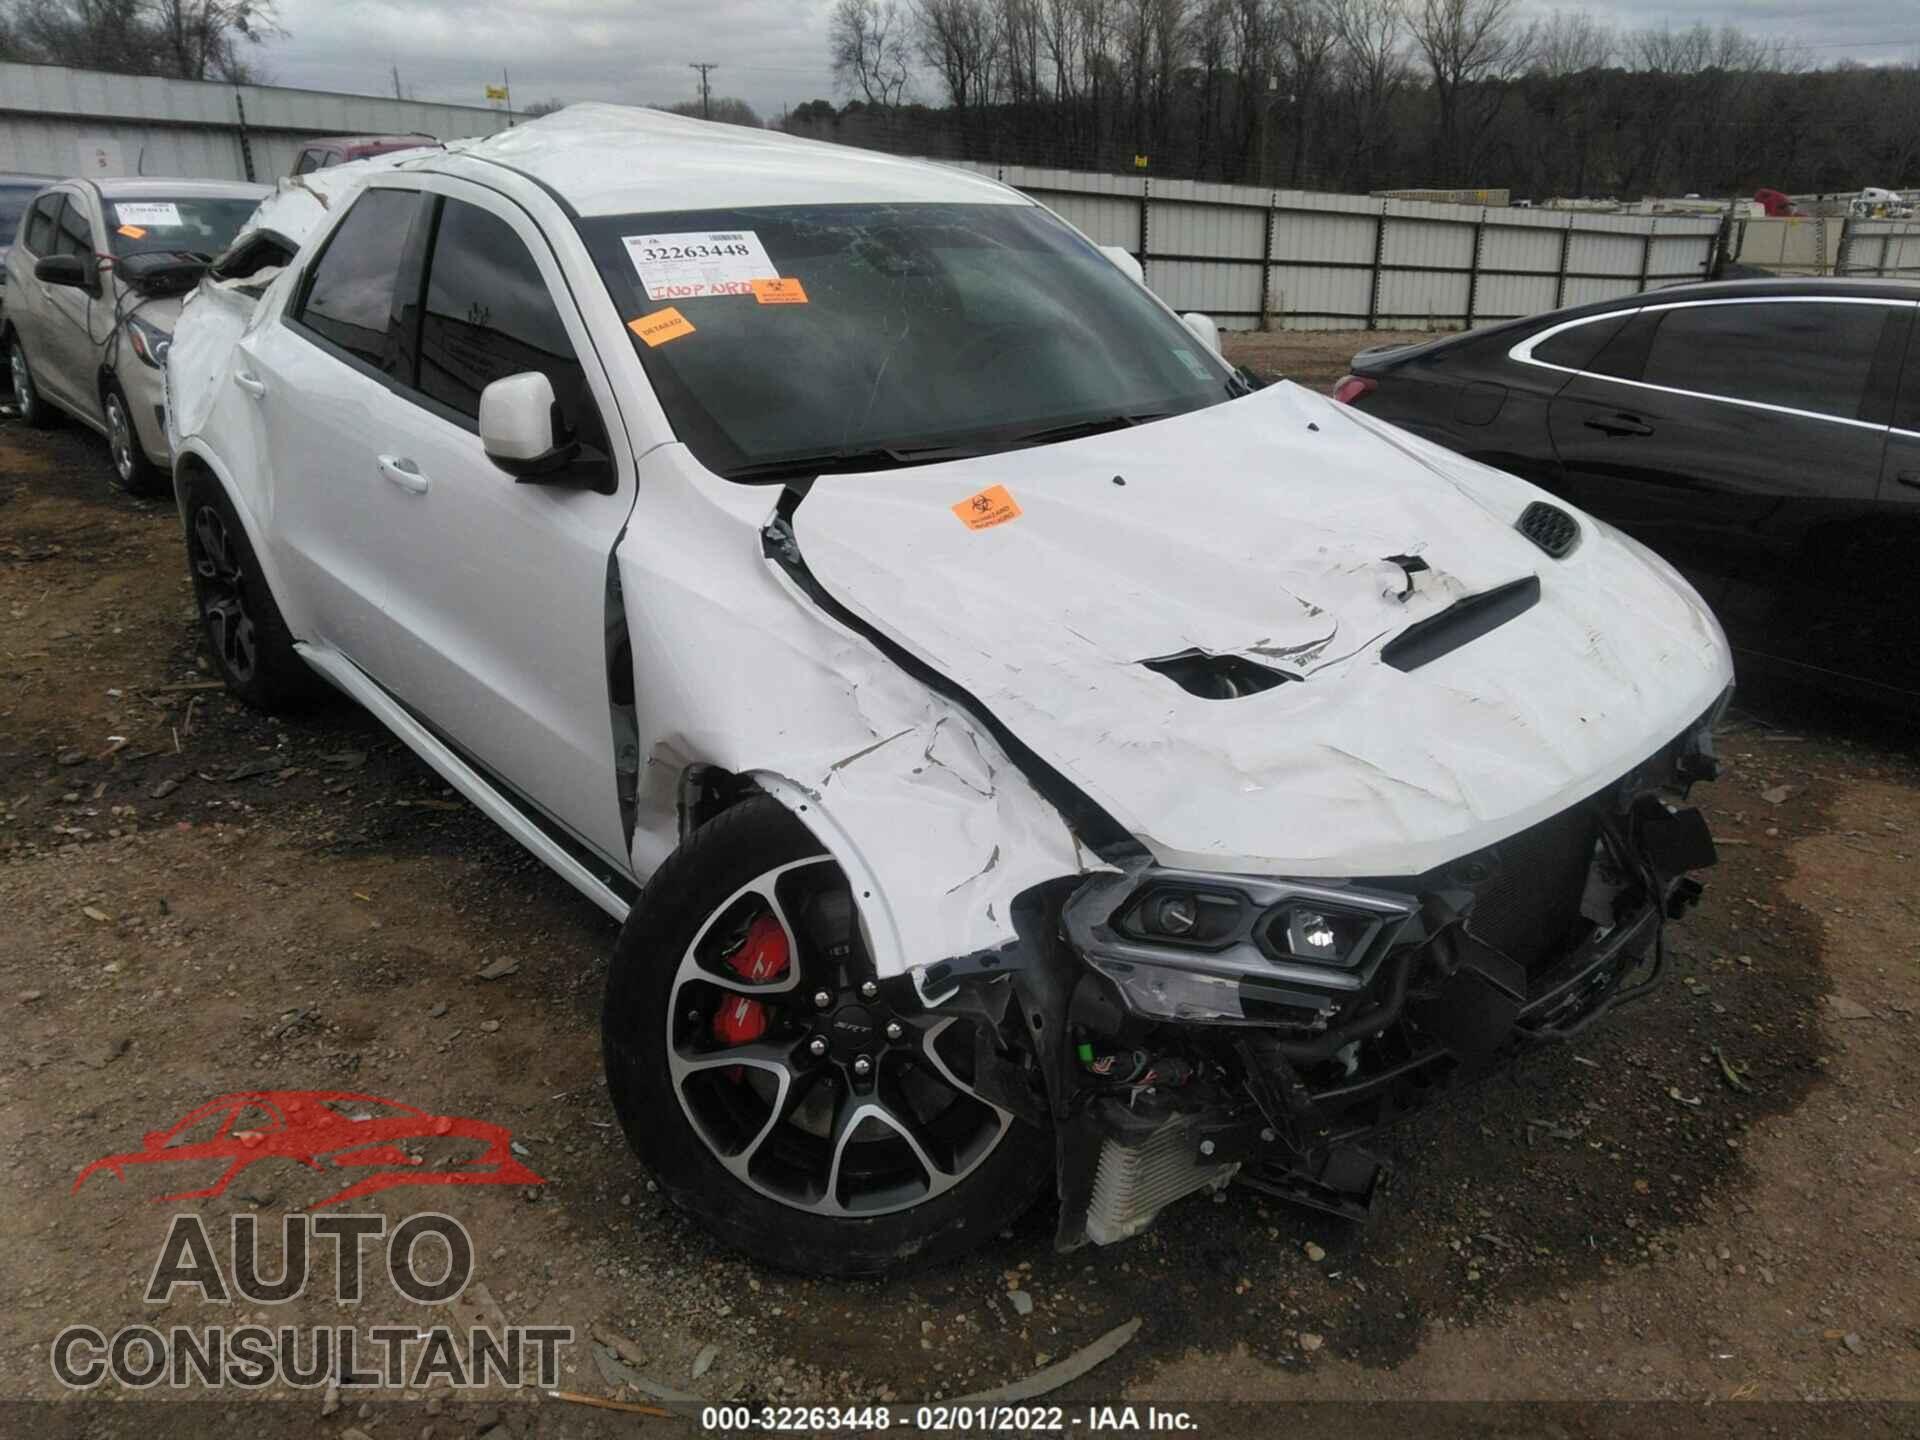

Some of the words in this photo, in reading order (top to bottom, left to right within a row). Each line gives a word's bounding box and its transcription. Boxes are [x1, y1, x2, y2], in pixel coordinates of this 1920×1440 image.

[643, 244, 750, 261] 32263448
[652, 284, 705, 299] INOP
[642, 318, 683, 336] DETAILED
